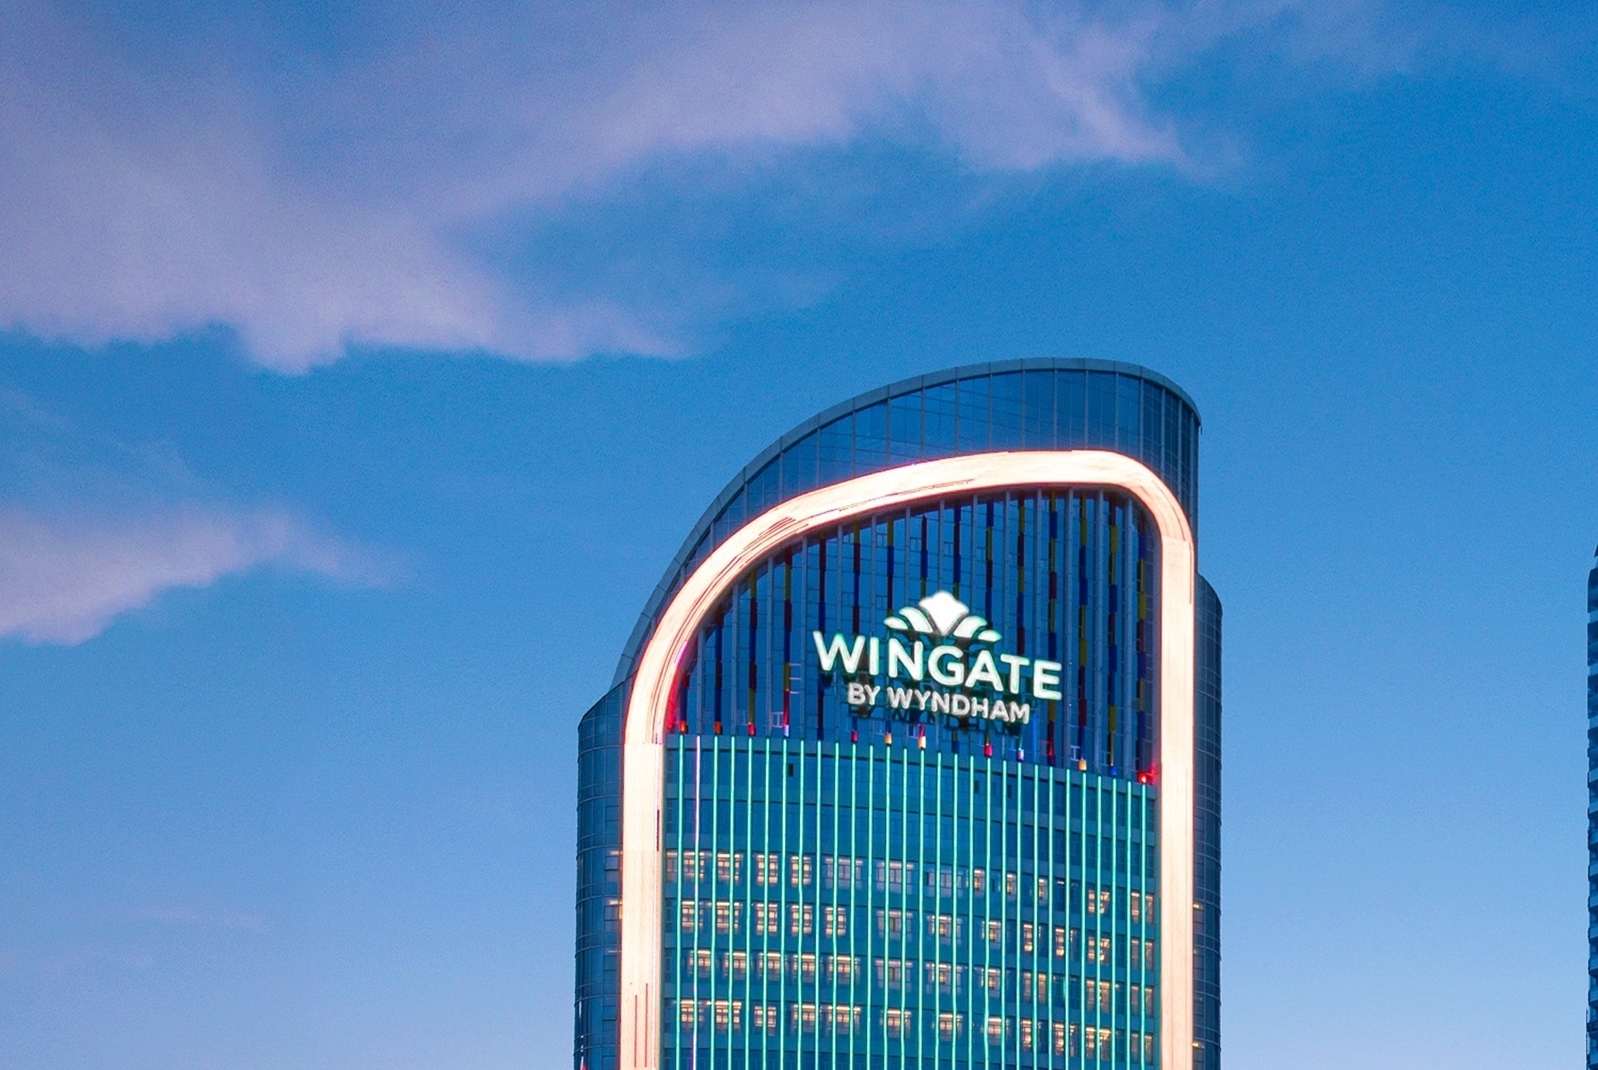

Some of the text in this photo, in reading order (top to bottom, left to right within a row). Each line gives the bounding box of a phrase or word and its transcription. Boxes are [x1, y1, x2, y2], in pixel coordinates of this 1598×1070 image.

[812, 630, 1063, 701] WINGATE
[847, 682, 1031, 725] BY WYNDHAM
